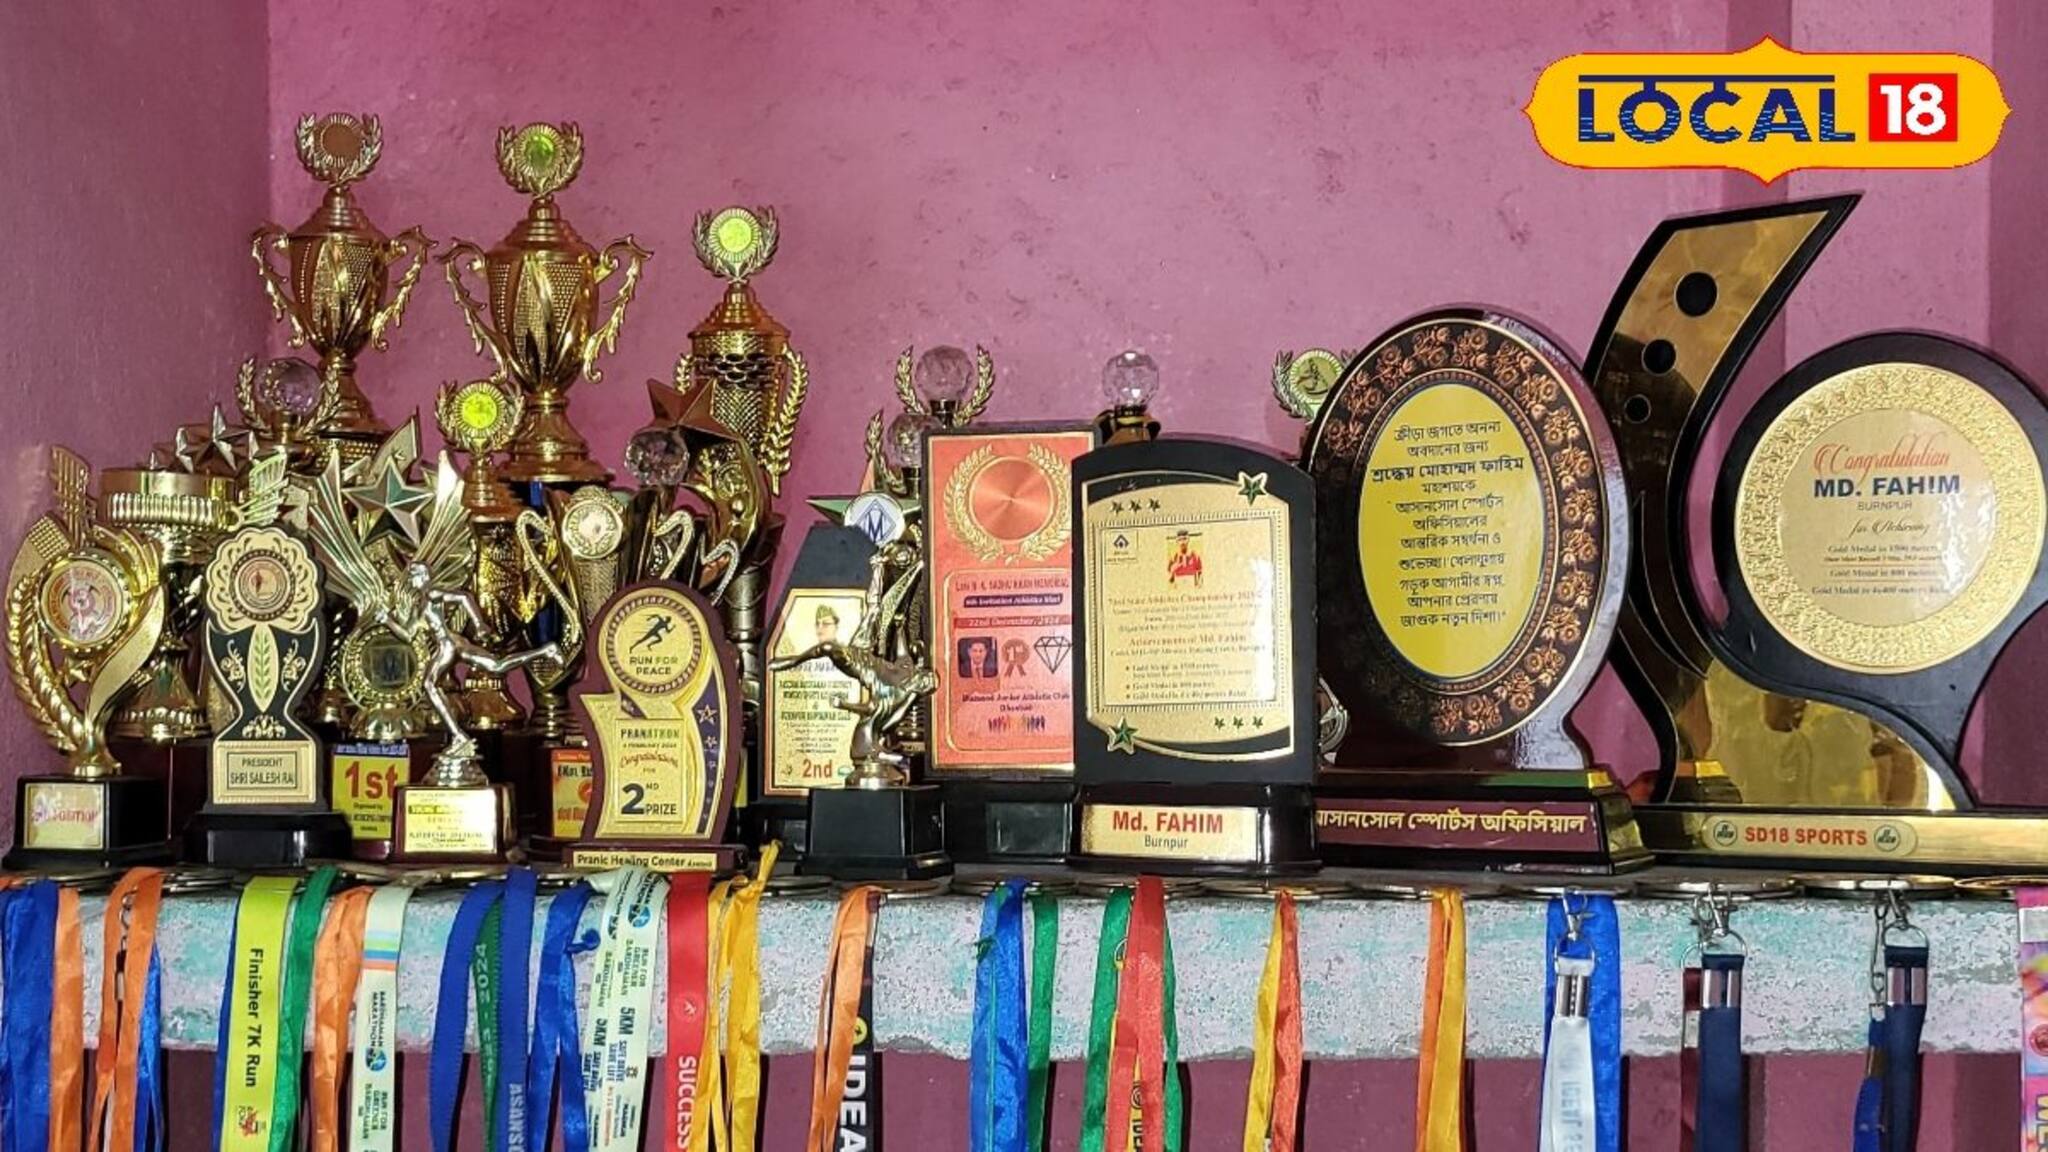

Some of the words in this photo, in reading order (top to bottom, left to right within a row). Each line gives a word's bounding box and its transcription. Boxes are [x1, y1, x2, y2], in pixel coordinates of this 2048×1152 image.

[1479, 454, 1524, 472] ফাহিম
[1814, 478, 1862, 498] MD.
[1857, 501, 1913, 511] BURNPUR
[1492, 532, 1501, 544] ও
[629, 656, 653, 665] RUN
[655, 656, 679, 665] FOR
[636, 666, 672, 675] PEACE
[241, 758, 283, 767] PRESIDENT
[802, 757, 833, 779] 2nd
[345, 760, 399, 800] 1st
[645, 803, 678, 815] PRIZE
[1113, 810, 1148, 831] Md.
[1156, 812, 1223, 834] FAHIM
[1408, 807, 1477, 831] স্পোর্টস
[1480, 809, 1587, 833] অফিসিয়াল
[1144, 835, 1189, 850] Burnpur
[1745, 826, 1790, 843] SD18
[1795, 828, 1868, 846] SPORTS
[577, 854, 608, 865] Pranic
[611, 855, 649, 867] Healing
[651, 855, 685, 867] Center
[475, 943, 491, 1003] 2024
[247, 948, 264, 1019] Finisher
[618, 1006, 636, 1035] 5KM
[247, 1024, 262, 1048] 7K
[245, 1054, 261, 1088] Run
[677, 1056, 697, 1150] SUCCESS
